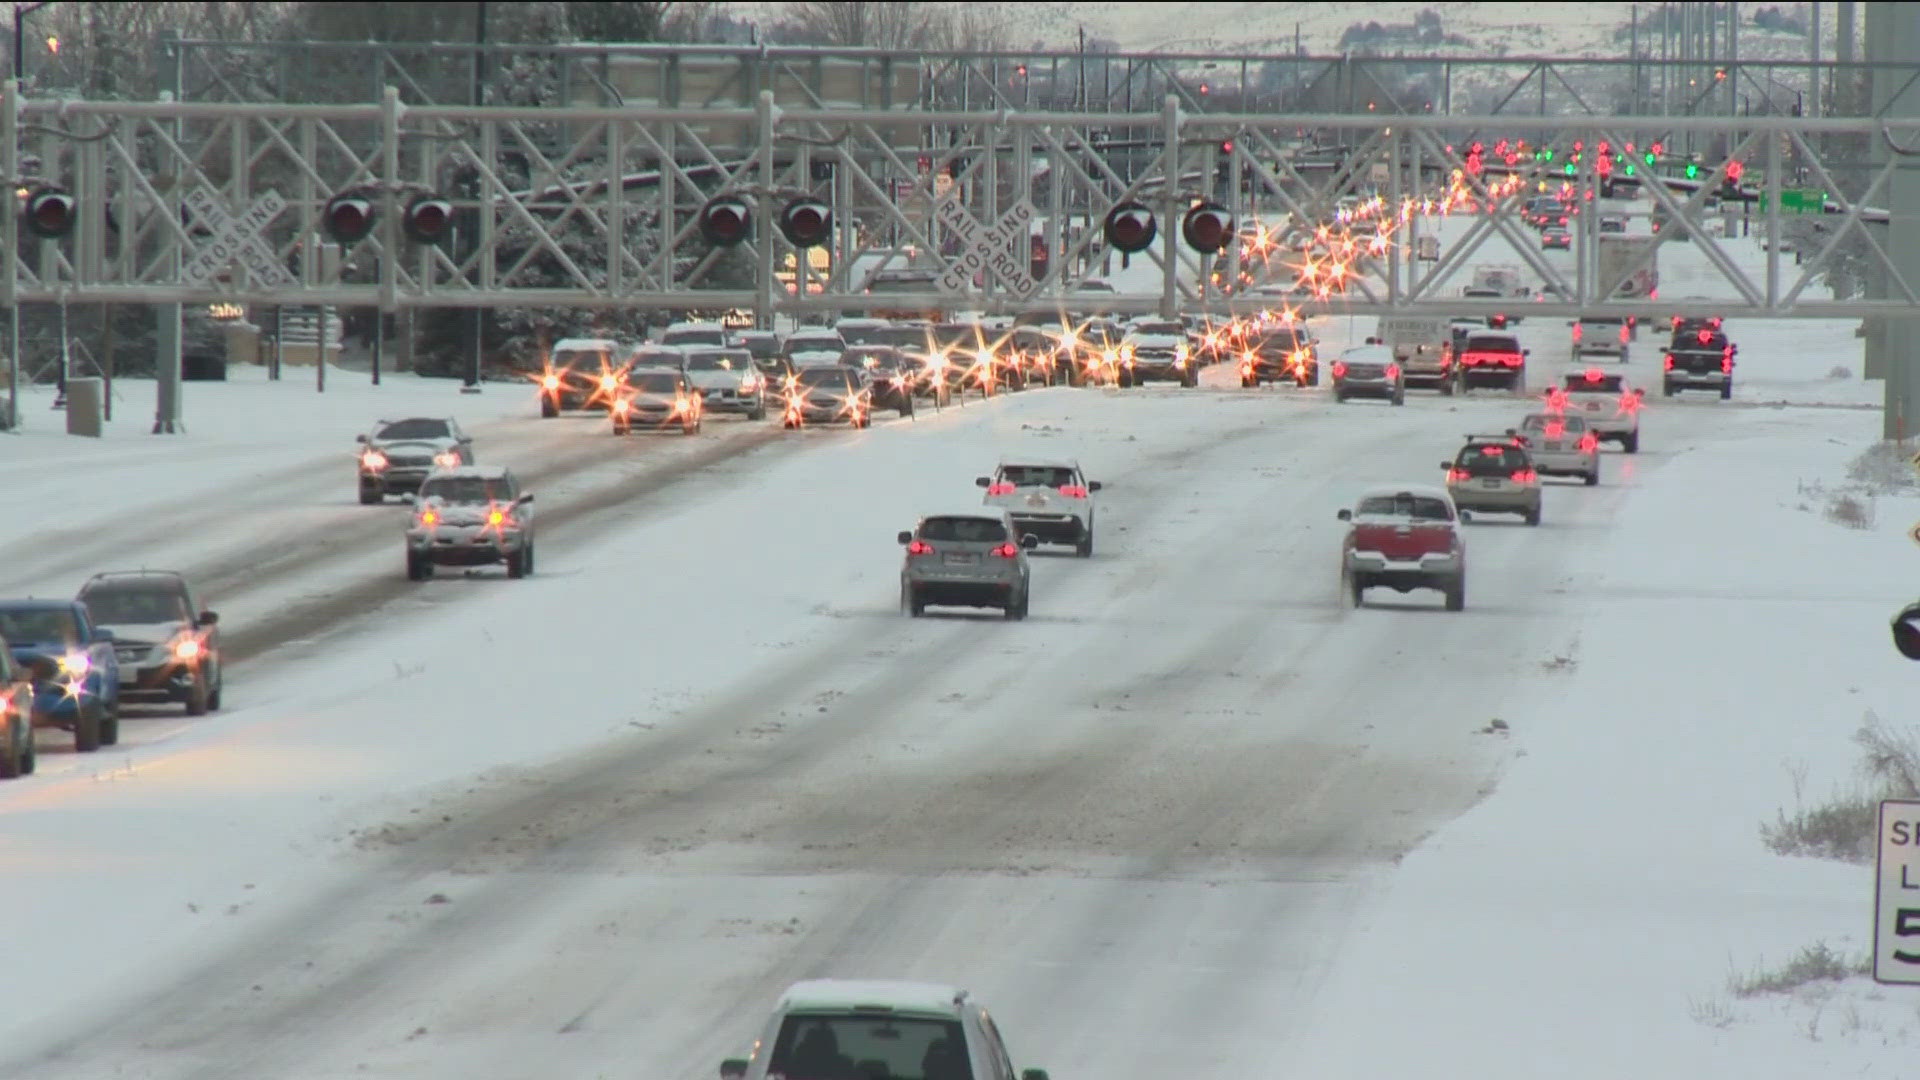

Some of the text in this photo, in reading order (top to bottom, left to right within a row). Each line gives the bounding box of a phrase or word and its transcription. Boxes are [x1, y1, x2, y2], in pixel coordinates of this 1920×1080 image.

[189, 198, 279, 281] CROSSING
[243, 244, 281, 287] ROAD
[940, 200, 1032, 293] RAIL ROAD
[943, 205, 1030, 290] CROSSING
[1890, 820, 1920, 847] S
